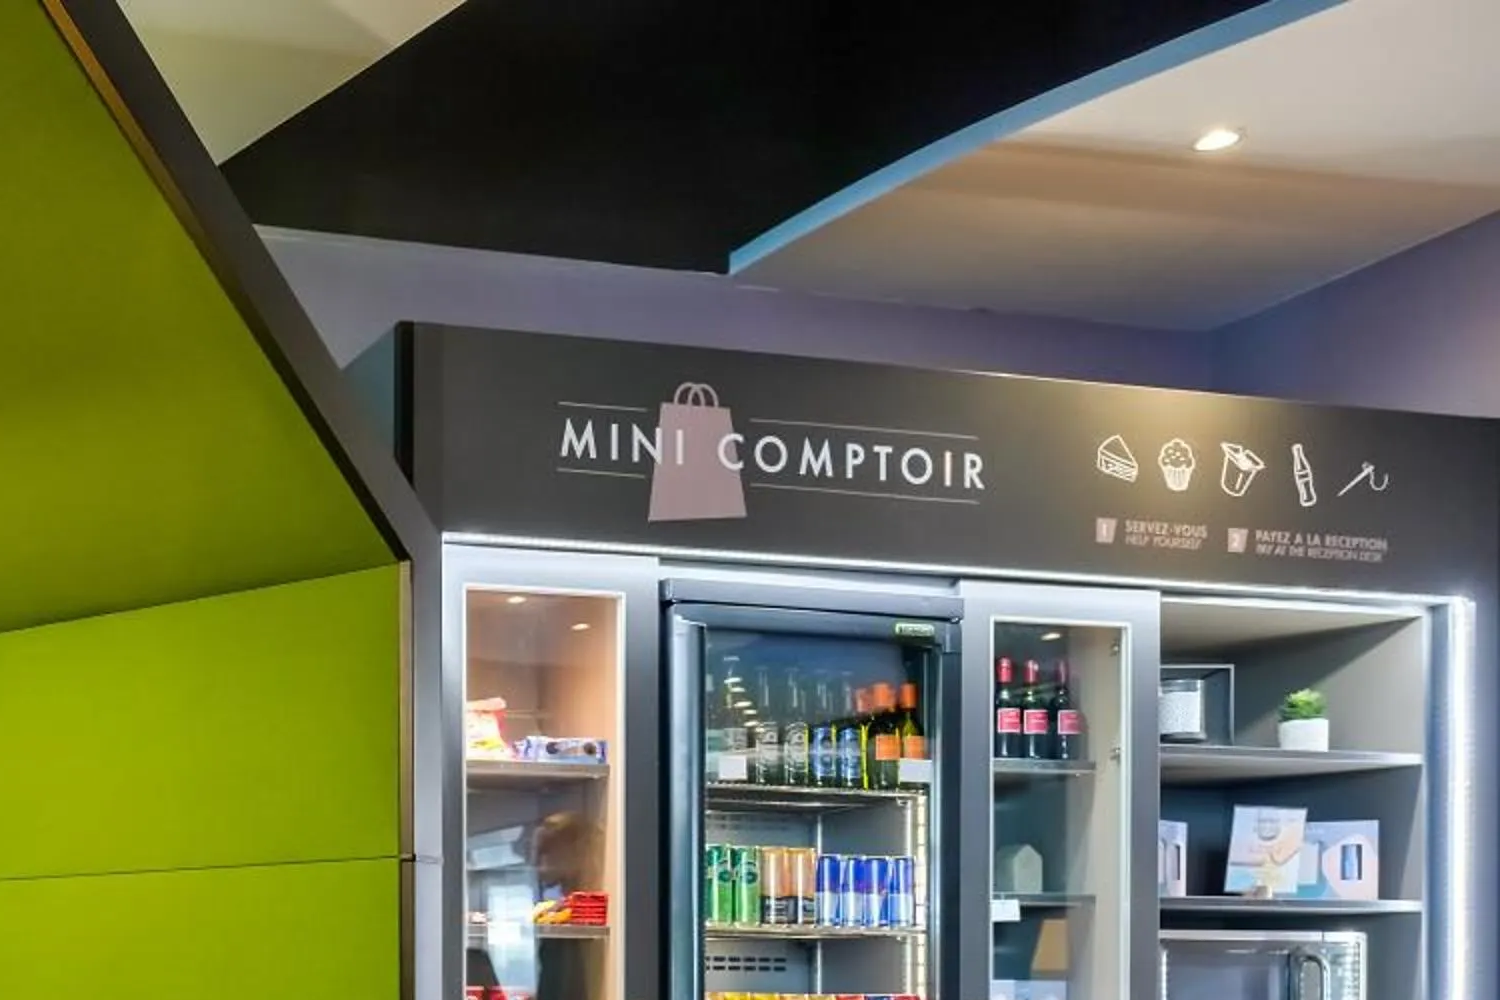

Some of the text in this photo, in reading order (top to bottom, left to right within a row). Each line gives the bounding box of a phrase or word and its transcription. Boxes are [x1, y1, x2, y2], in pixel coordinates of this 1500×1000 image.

[560, 417, 986, 491] MINI COMPTOIR
[1125, 519, 1208, 539] SERVEZ-VOUS
[1255, 529, 1389, 552] PAYEZ A LA RECEPTION
